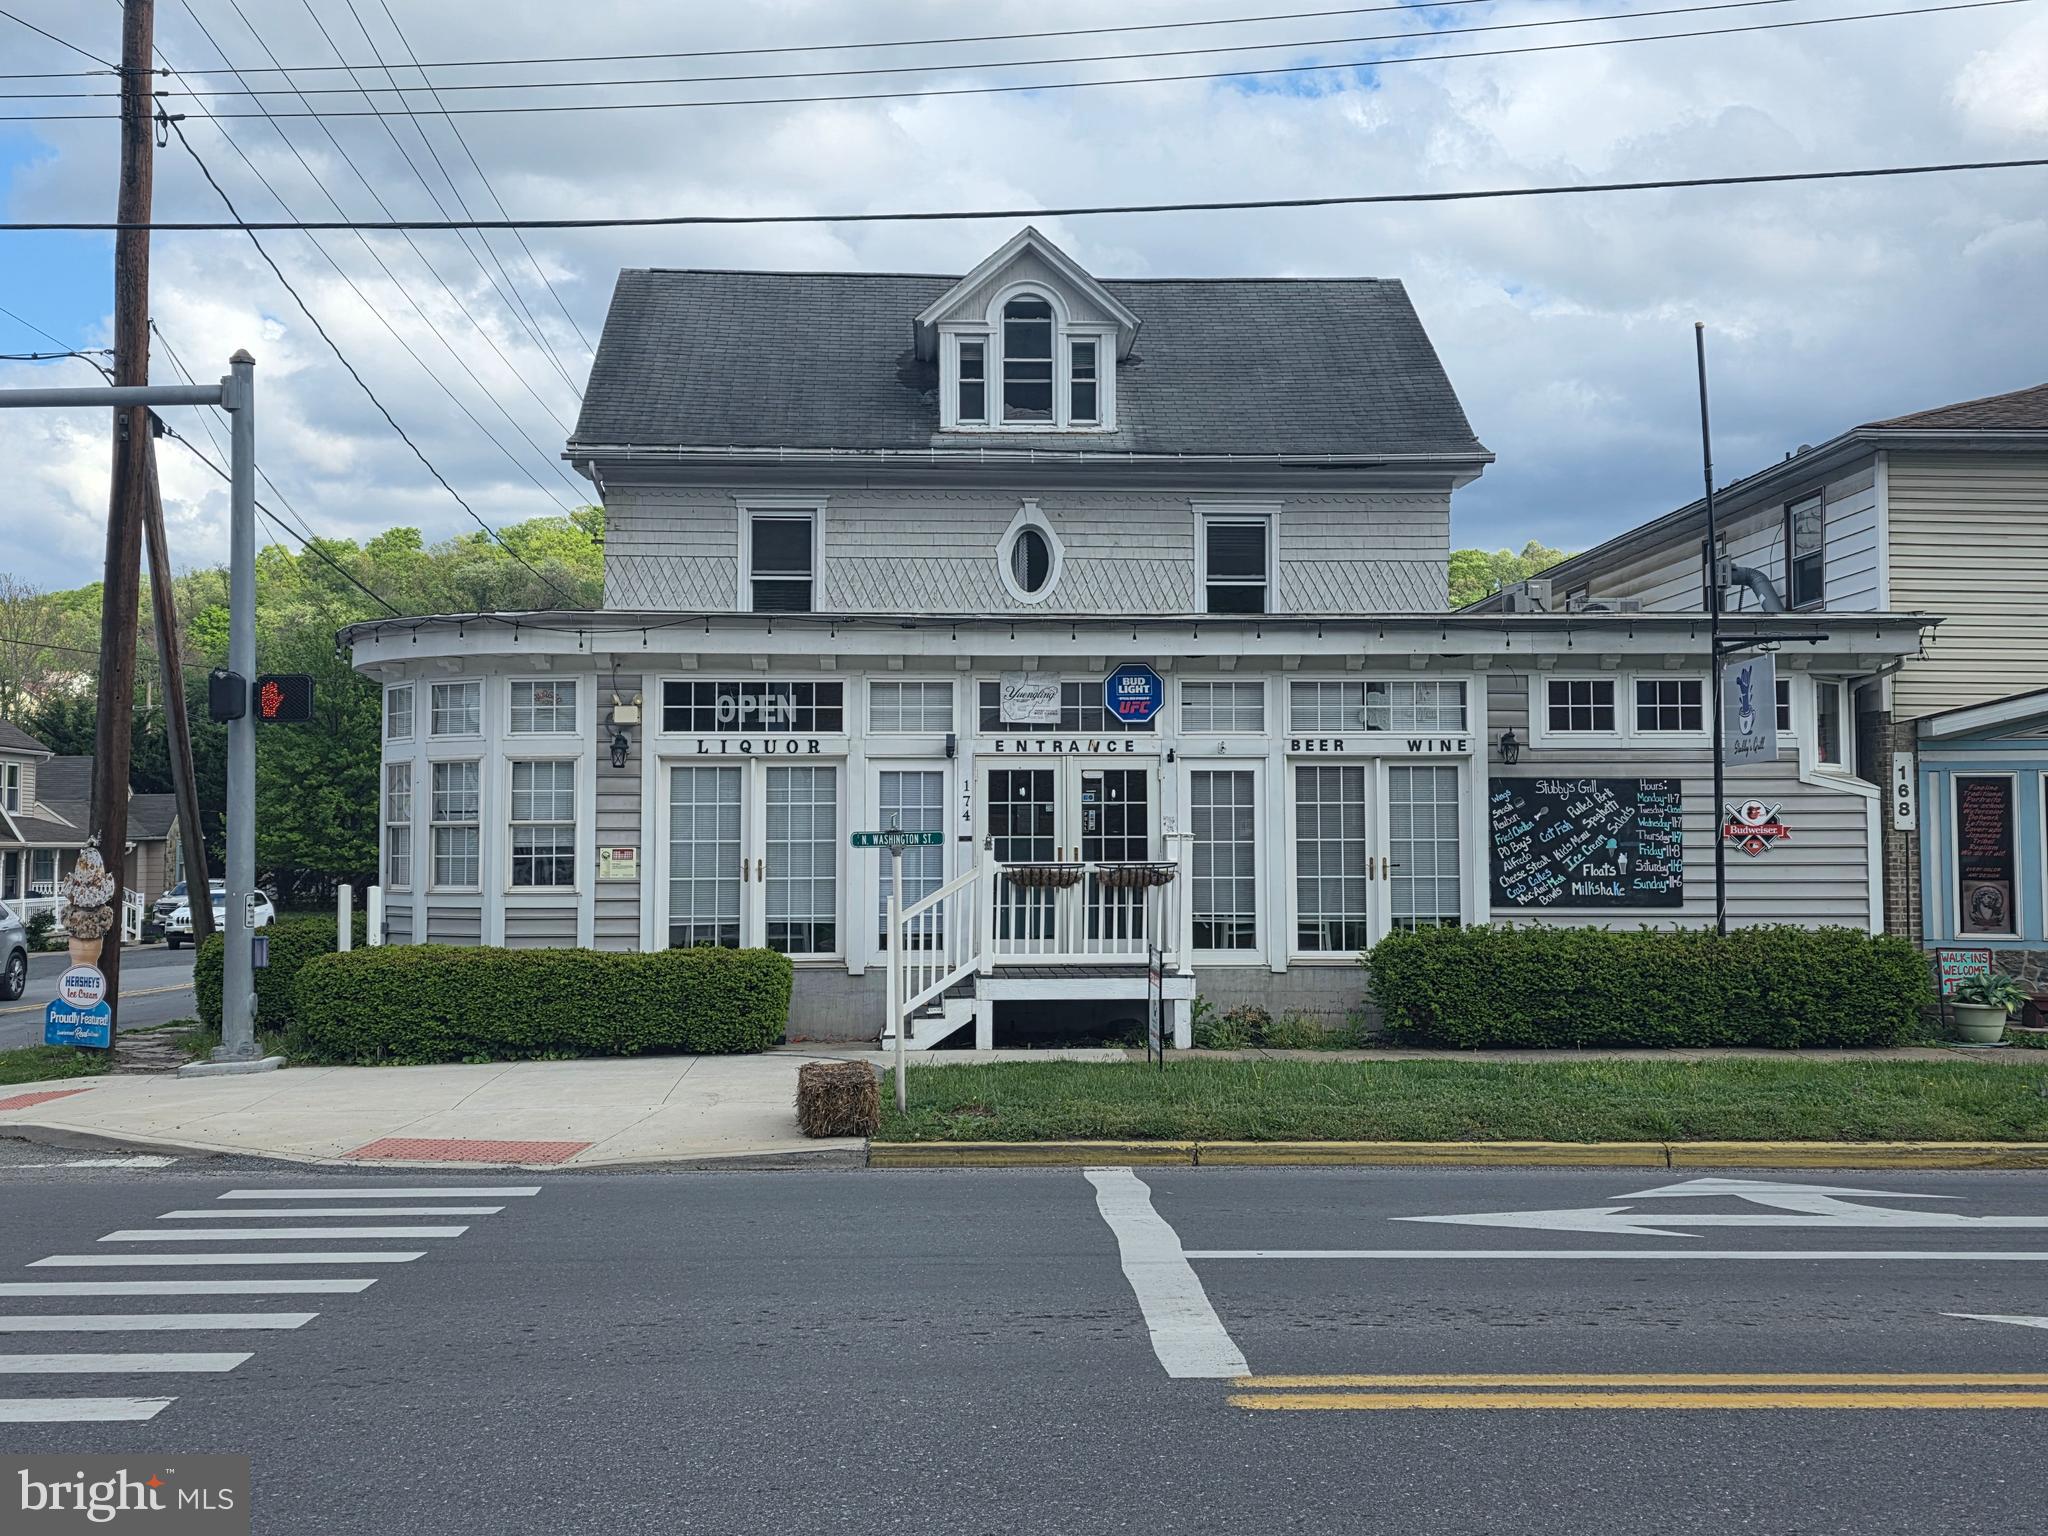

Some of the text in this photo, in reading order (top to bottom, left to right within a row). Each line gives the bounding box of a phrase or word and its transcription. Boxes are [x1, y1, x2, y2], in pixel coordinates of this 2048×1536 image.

[1118, 685, 1150, 694] LIGHT
[1122, 677, 1146, 686] BUD
[1004, 685, 1056, 704] Yuengling
[717, 694, 797, 723] OPEN
[1119, 701, 1152, 714] UFC
[697, 739, 821, 754] LIQUOR
[995, 739, 1134, 753] ENTRANCE
[1291, 739, 1467, 752] BEER WINE
[1535, 779, 1598, 800] Stubby's Grill
[1897, 765, 1911, 817] 168
[962, 779, 971, 822] 174
[1566, 788, 1615, 818] Pulled Pork
[1582, 800, 1620, 829] Spaghetti
[1607, 806, 1635, 835] Salads
[1494, 829, 1515, 845] Fried
[1539, 819, 1574, 843] Cat Fish
[1729, 825, 1778, 834] Budweiser
[872, 834, 919, 845] WASHINGTON
[922, 833, 935, 844] ST.
[1510, 836, 1532, 853] Boy's
[1552, 843, 1573, 861] Kids
[1562, 834, 1608, 872] Ice Cream
[1503, 852, 1532, 872] Alfredo
[1583, 862, 1617, 876] Floats
[1499, 855, 1552, 888] Cheese Steak
[1506, 868, 1552, 899] Crab Cakes
[1539, 886, 1562, 905] Bowls
[1941, 952, 1988, 964] WALK-INS
[1942, 965, 1988, 976] WELCOME
[67, 988, 98, 999] Ice Cream
[50, 1011, 80, 1026] Proudly
